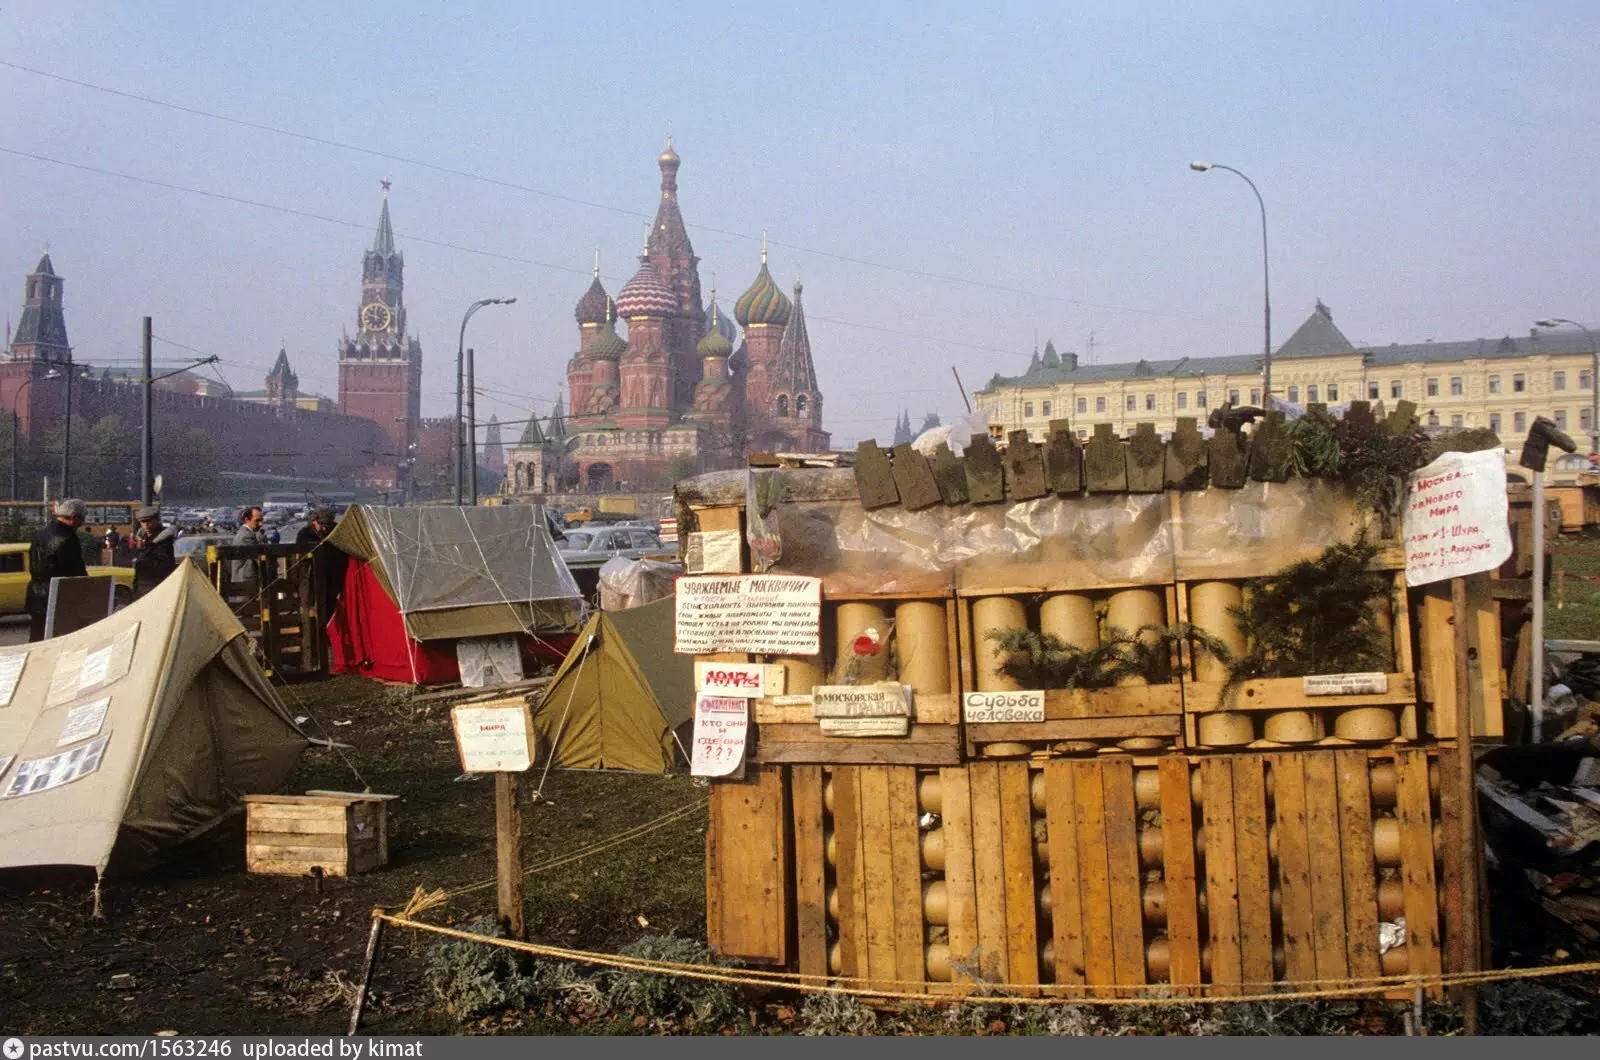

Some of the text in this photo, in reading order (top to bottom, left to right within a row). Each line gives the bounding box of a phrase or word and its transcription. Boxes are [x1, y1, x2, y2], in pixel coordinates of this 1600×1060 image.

[684, 579, 811, 594] УВАЖАЕМЫЕ МОСКВИЧИ!
[966, 693, 1041, 712] Судьба
[967, 708, 1043, 721] человека
